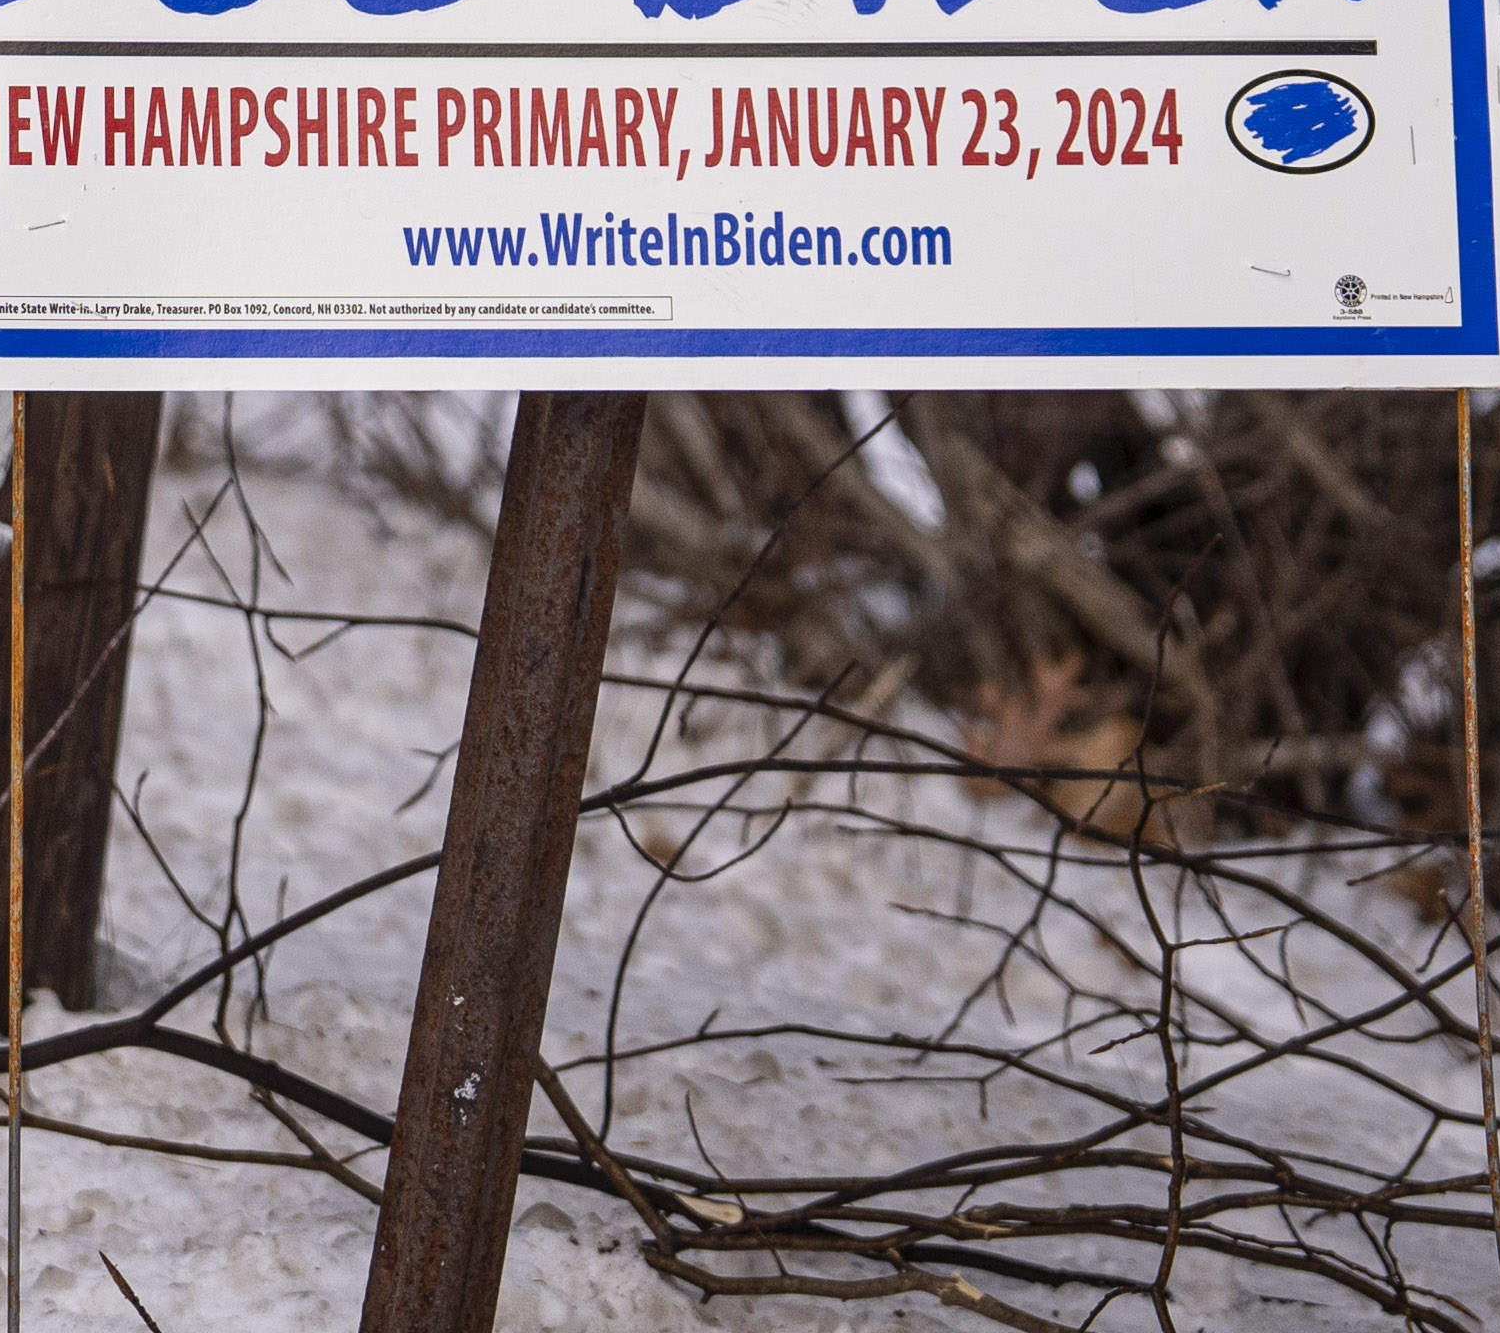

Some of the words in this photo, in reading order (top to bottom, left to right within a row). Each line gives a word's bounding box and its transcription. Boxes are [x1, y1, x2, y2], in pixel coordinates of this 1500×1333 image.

[104, 86, 419, 168] HAMPSHIRE
[437, 87, 691, 182] PRIMARY,
[704, 86, 947, 168] JANUARY
[961, 88, 1041, 181] 23,
[1055, 87, 1183, 167] 2024
[402, 211, 952, 267] www.WriteInBiden.com
[20, 302, 48, 315] State
[95, 303, 121, 317] Larry
[122, 302, 155, 315] Drake,
[156, 302, 207, 315] Treasurer.
[208, 302, 222, 315] PO
[223, 302, 242, 315] Box
[244, 302, 271, 315] 1092,
[273, 302, 315, 315] Concord,
[317, 302, 332, 315] NH
[333, 302, 367, 315] 03302.
[369, 302, 387, 315] Not
[388, 302, 443, 315] authorized
[444, 303, 457, 317] by
[458, 306, 476, 317] any
[478, 302, 527, 315] candidate
[529, 306, 540, 315] or
[598, 302, 655, 315] committee.
